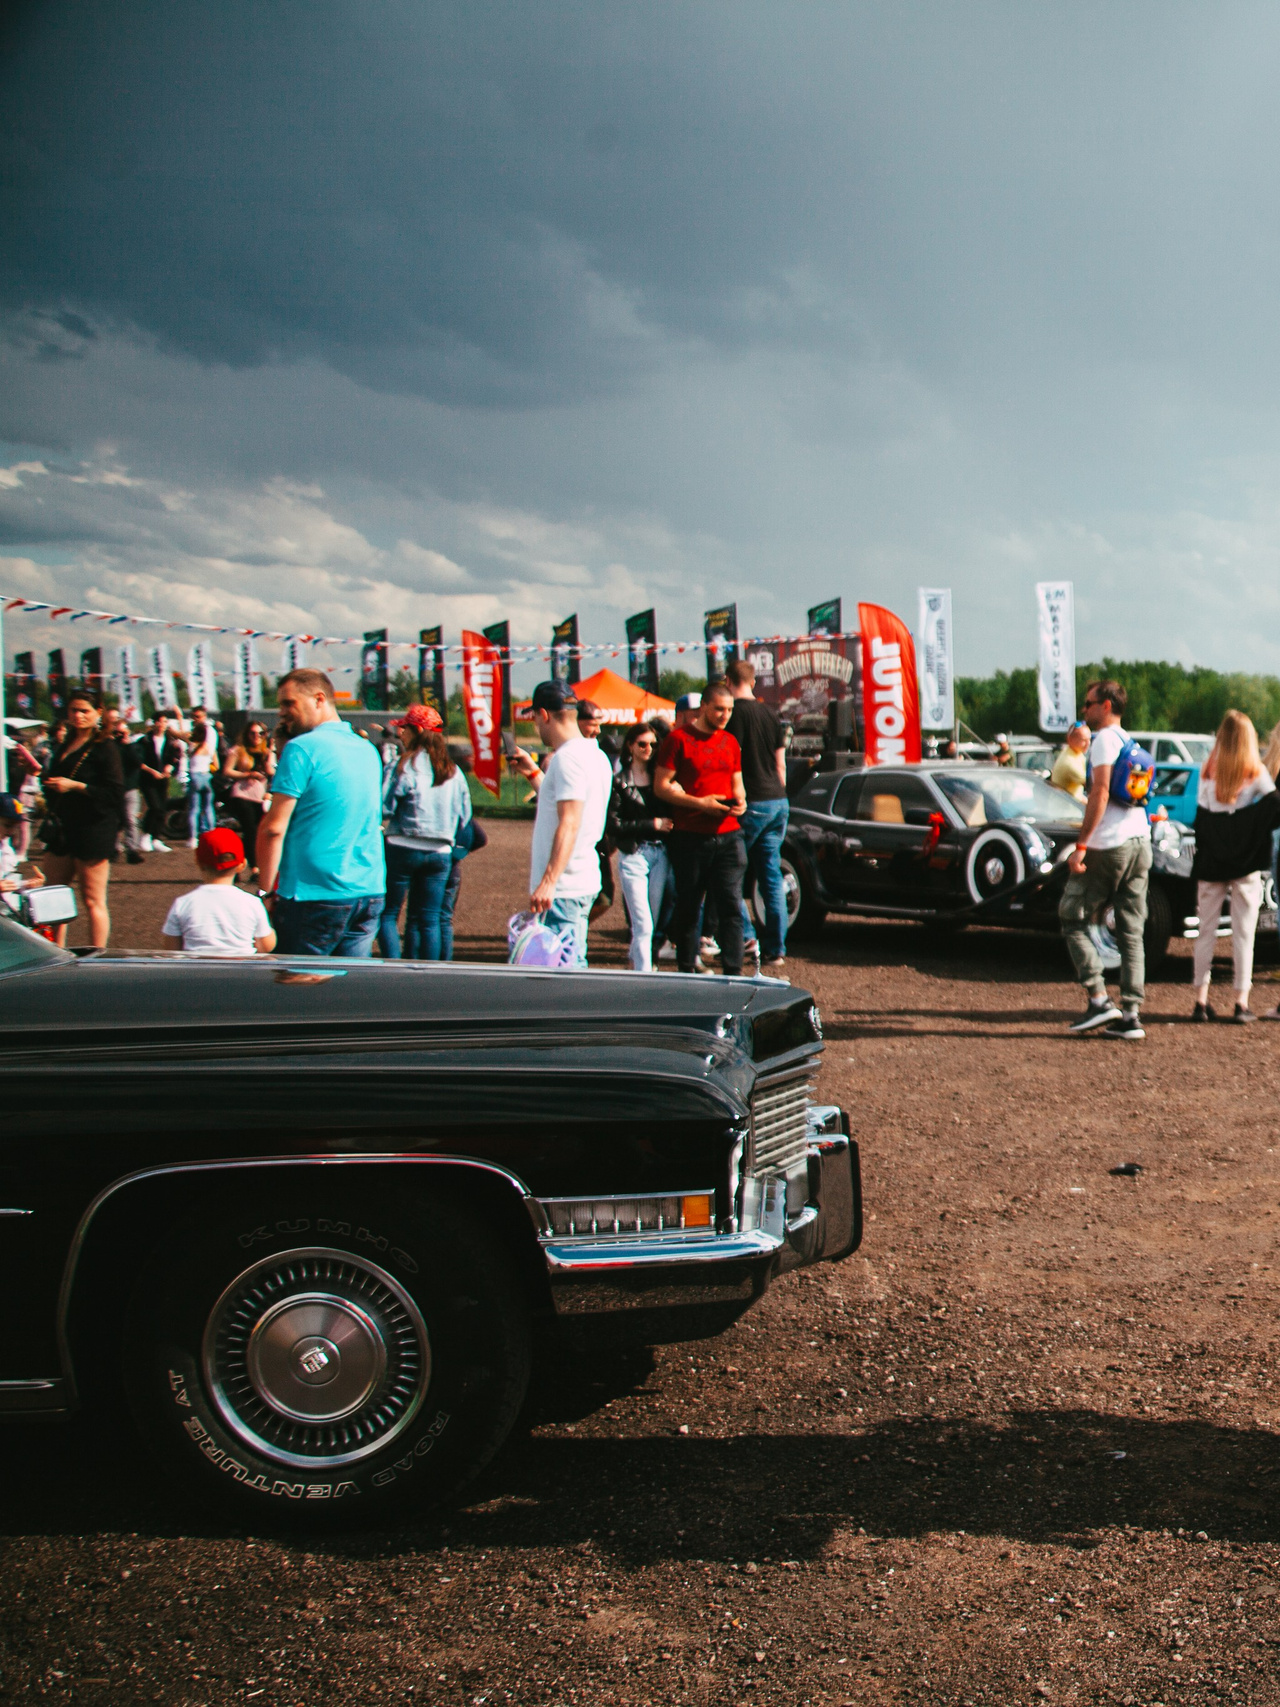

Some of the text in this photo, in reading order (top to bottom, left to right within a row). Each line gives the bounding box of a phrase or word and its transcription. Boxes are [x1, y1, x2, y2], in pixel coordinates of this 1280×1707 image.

[777, 651, 854, 687] RUSSIAN WEEKEND
[597, 708, 638, 724] OTUL
[238, 1218, 419, 1273] KUMHO
[168, 1369, 451, 1499] ROAD VENTURE AT
